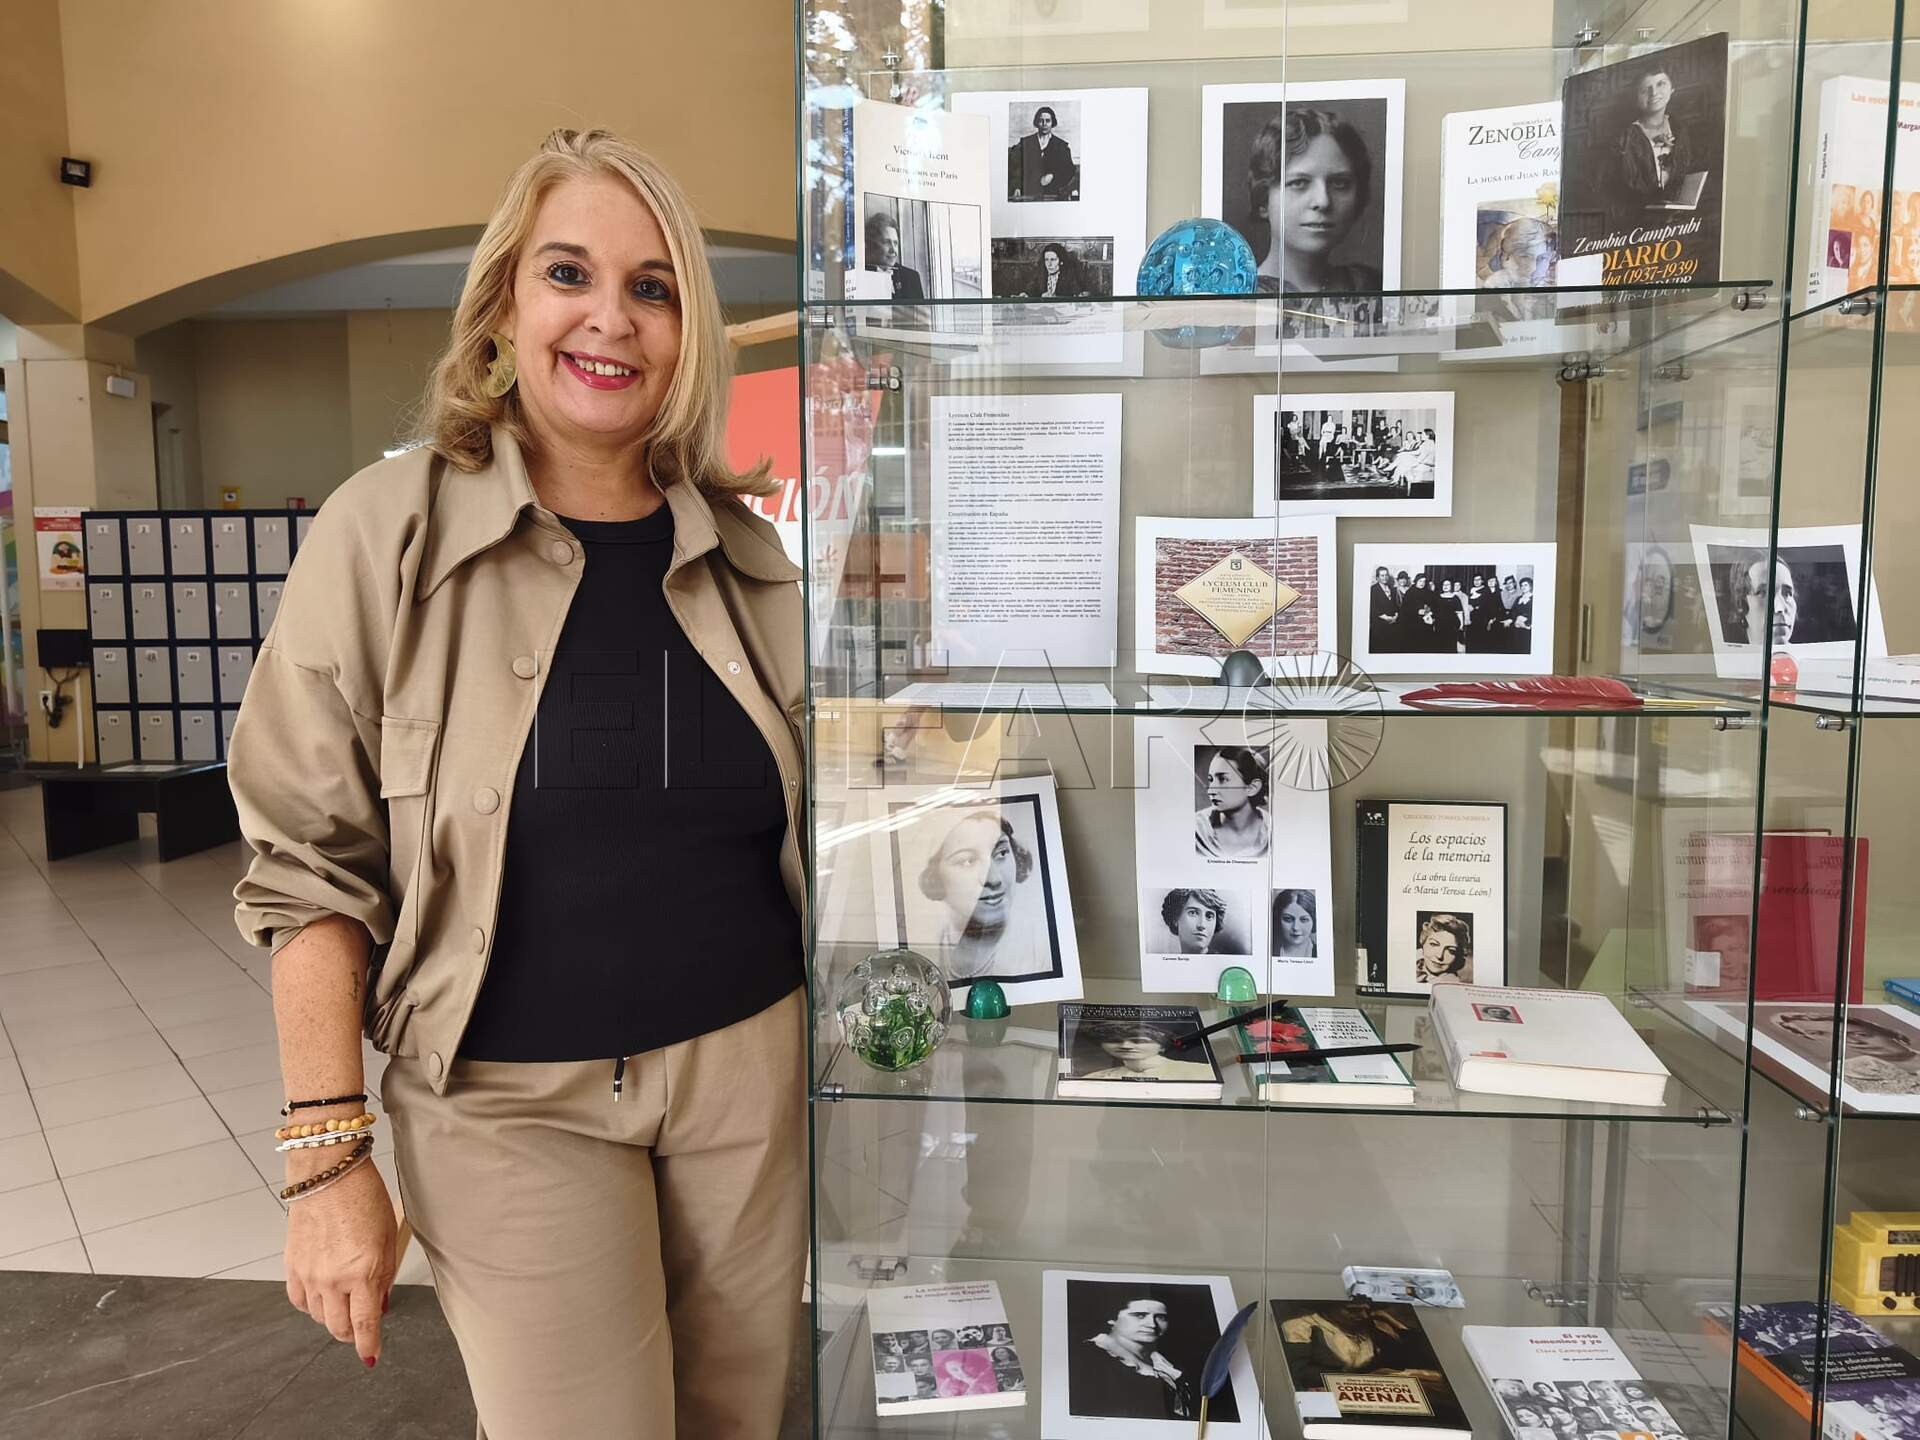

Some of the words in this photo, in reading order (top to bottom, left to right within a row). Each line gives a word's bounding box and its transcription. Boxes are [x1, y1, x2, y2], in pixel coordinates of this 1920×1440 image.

[1468, 123, 1556, 146] ZENOBIA
[1574, 232, 1628, 254] Zenobia
[1628, 217, 1702, 245] Camprubí
[1624, 259, 1698, 285] (1937-1939)
[740, 466, 866, 522] CIÓN
[1408, 831, 1432, 844] Los
[1436, 832, 1487, 849] espacios
[1404, 846, 1418, 861] de
[1422, 846, 1434, 861] la
[1438, 850, 1492, 863] memoria
[1428, 872, 1447, 882] obra
[1402, 884, 1412, 894] de
[1338, 1392, 1420, 1404] ARENAL
